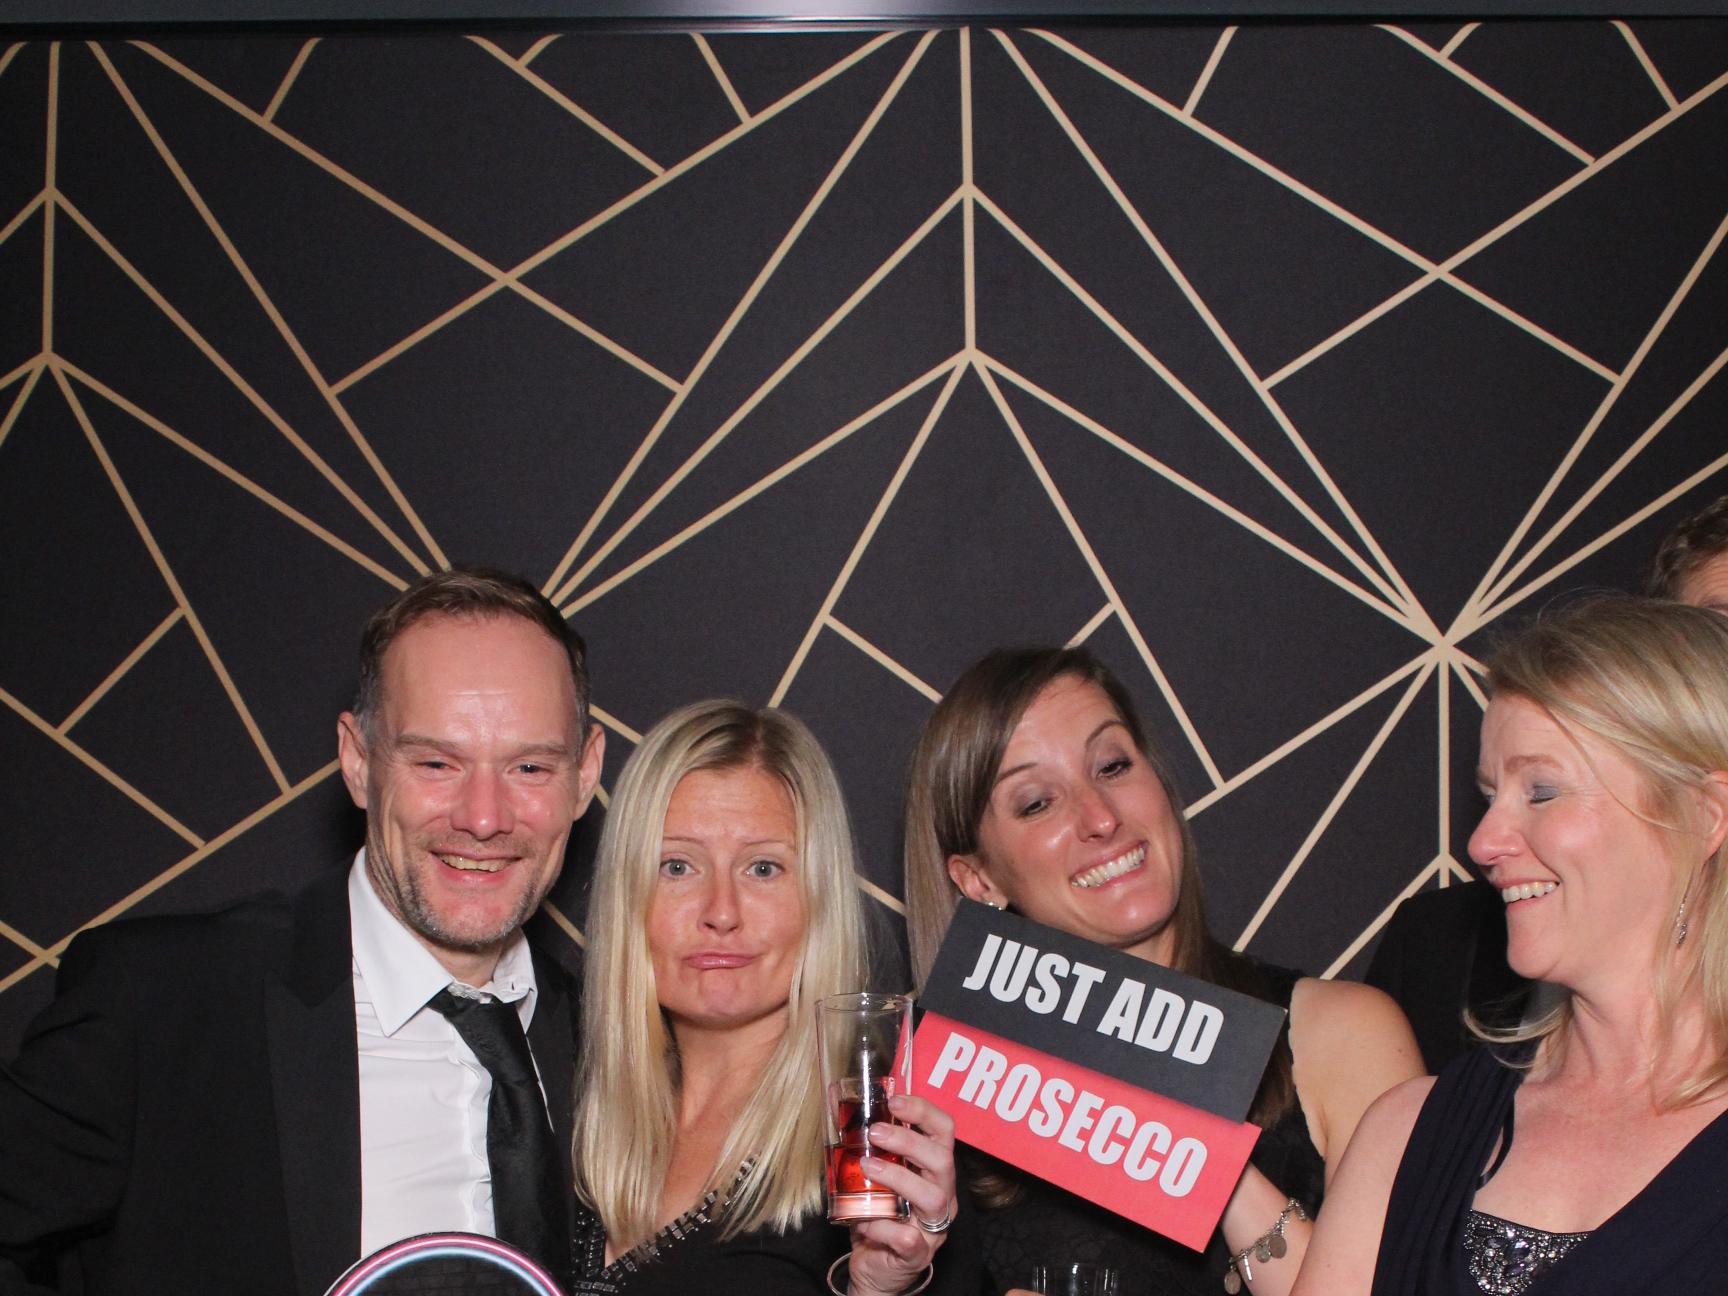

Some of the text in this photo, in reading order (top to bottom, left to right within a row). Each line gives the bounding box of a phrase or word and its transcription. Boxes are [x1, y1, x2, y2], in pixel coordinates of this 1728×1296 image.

[962, 933, 1224, 1065] JUST ADD
[927, 1032, 1207, 1197] PROSECCO
